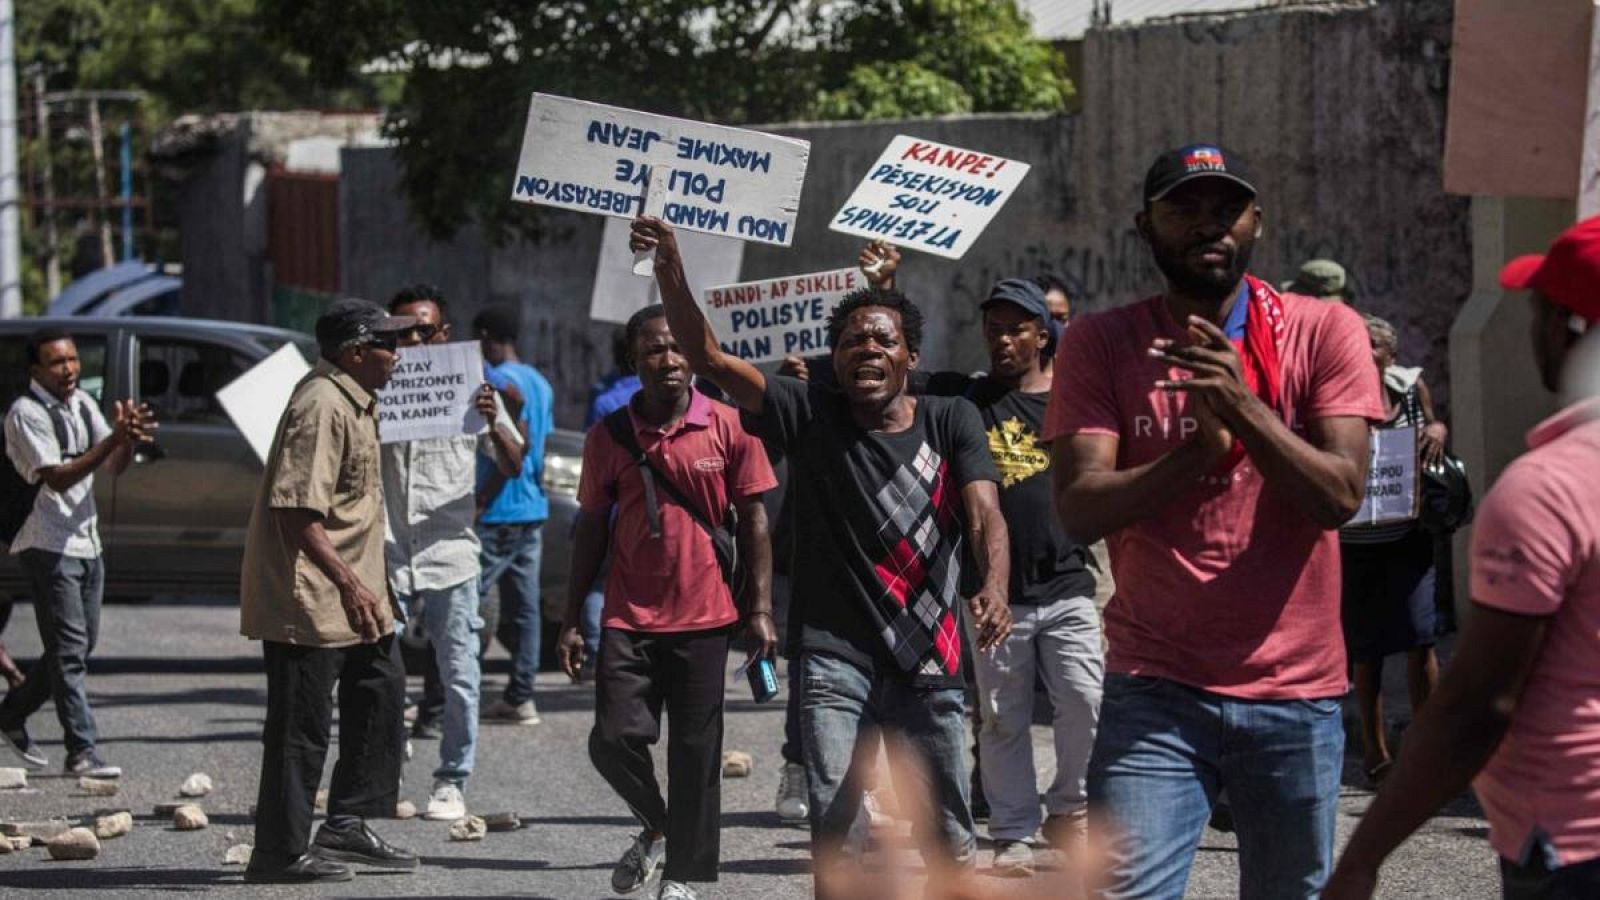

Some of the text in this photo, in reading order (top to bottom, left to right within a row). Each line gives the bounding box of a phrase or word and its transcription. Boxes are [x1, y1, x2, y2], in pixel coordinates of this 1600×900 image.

[588, 120, 771, 173] MAXIME JEAN
[901, 142, 1006, 178] KANPE!
[516, 175, 788, 242] NOU MAND LIBERASYON
[889, 194, 940, 215] SOU
[924, 226, 962, 249] LA
[771, 281, 790, 299] AP
[795, 272, 856, 296] SIKILE
[731, 298, 824, 333] POLISYE
[393, 361, 432, 375] ATAY
[391, 373, 465, 390] PRIZONYE
[435, 390, 455, 401] YO
[378, 406, 452, 421] PA KANPE
